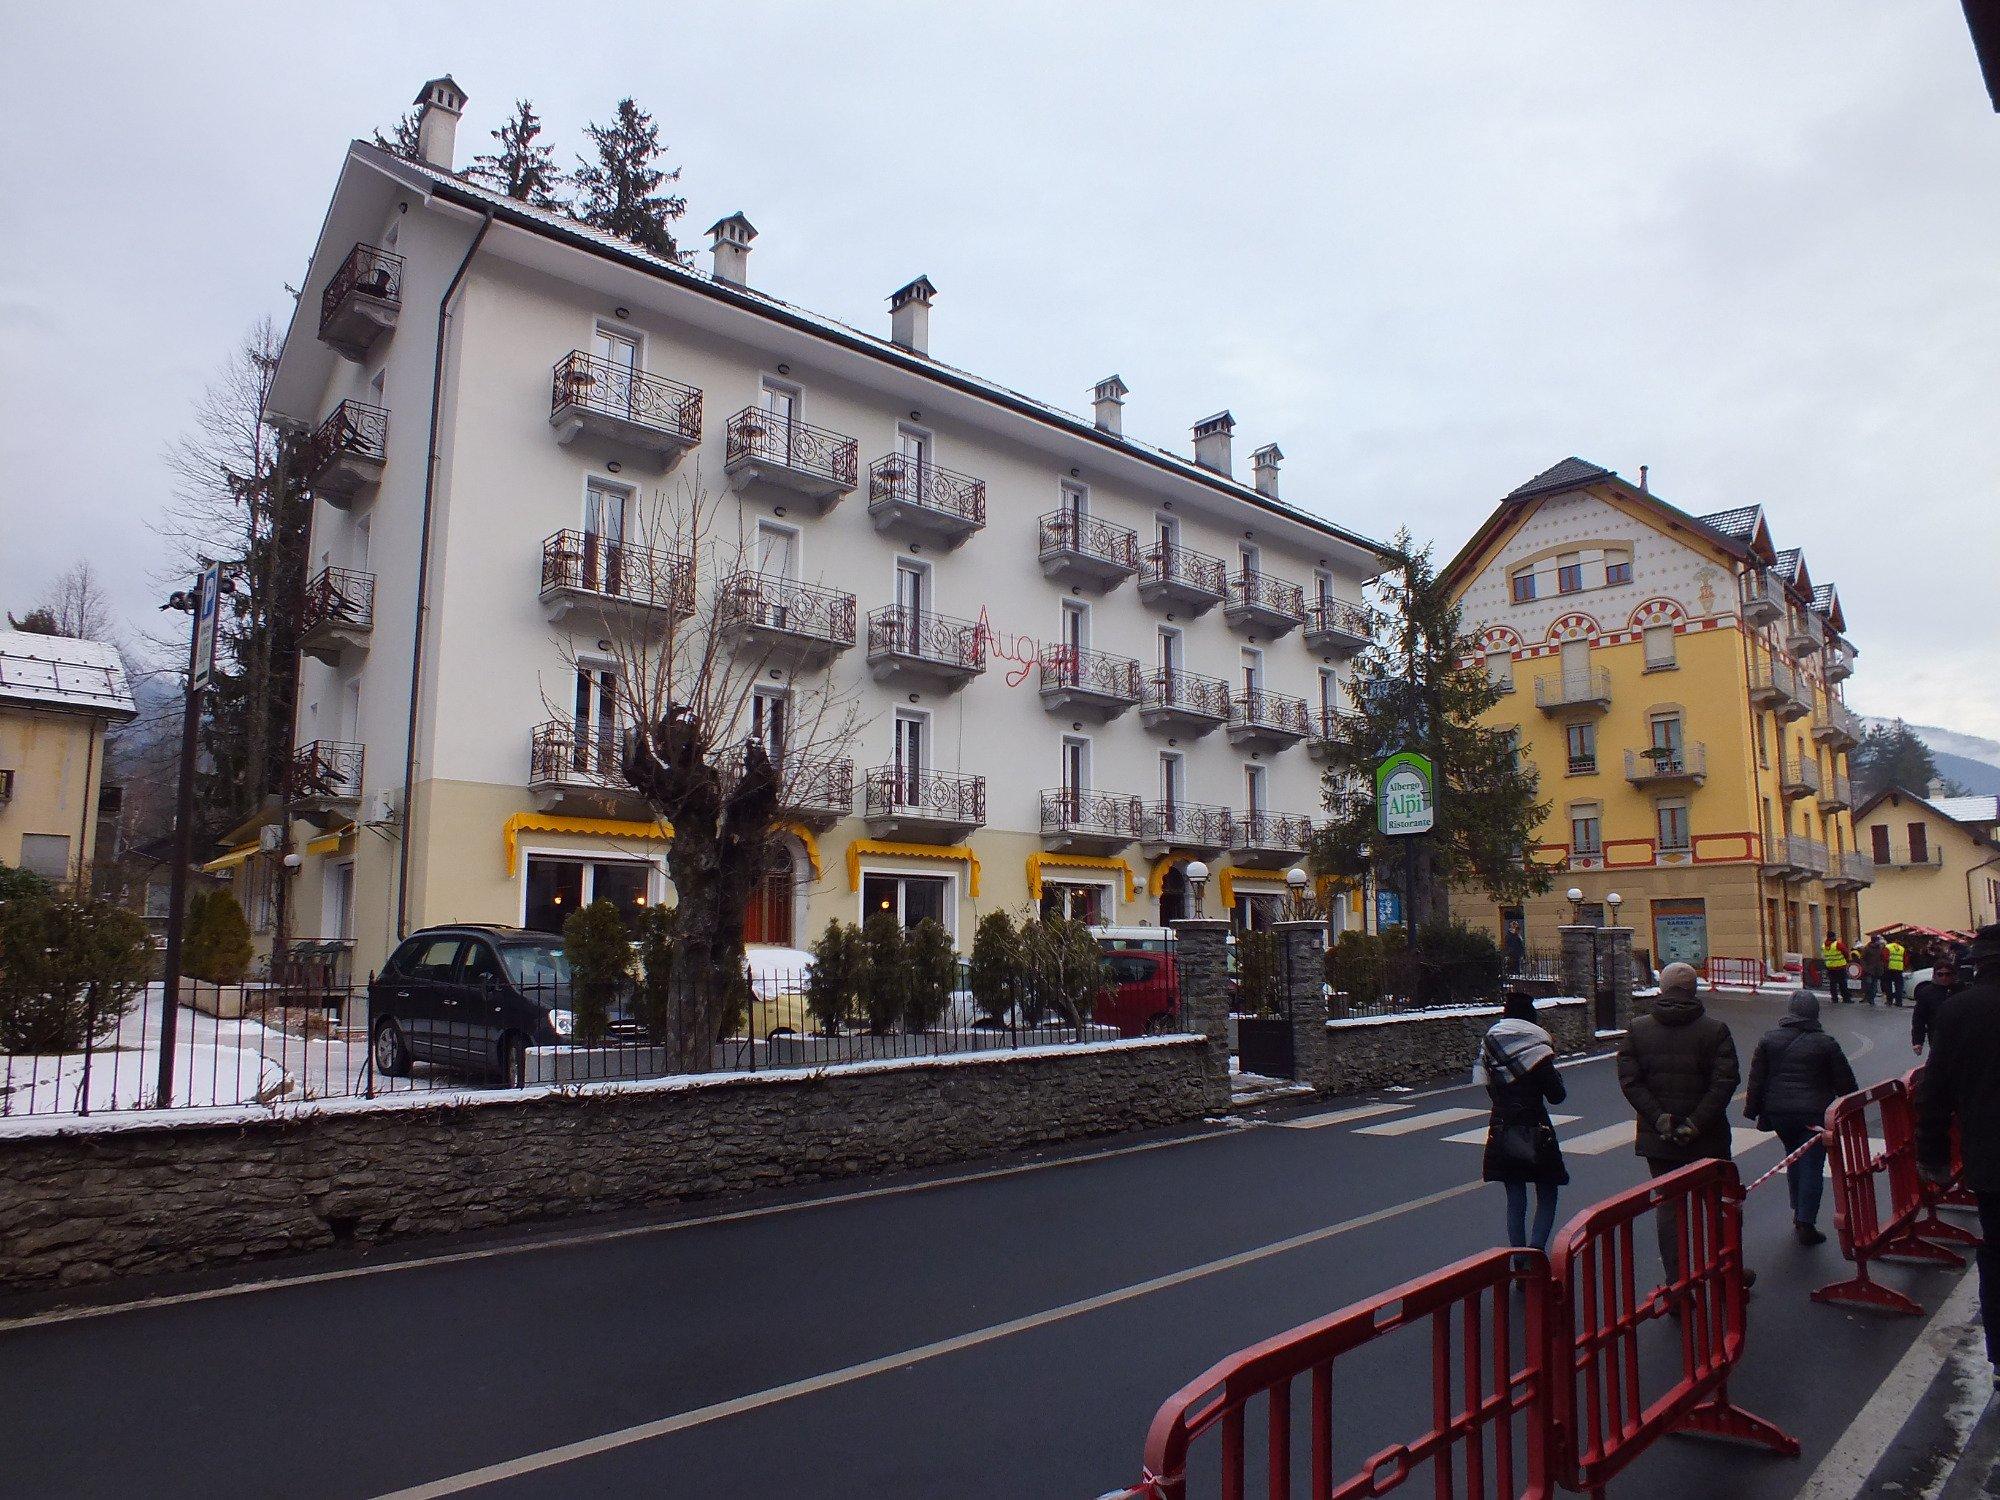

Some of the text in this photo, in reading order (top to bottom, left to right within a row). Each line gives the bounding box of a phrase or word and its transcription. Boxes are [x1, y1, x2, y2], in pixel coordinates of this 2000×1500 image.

[1390, 782, 1420, 792] Albergo
[1389, 794, 1422, 818] Alpi
[1388, 819, 1431, 829] Ristorante
